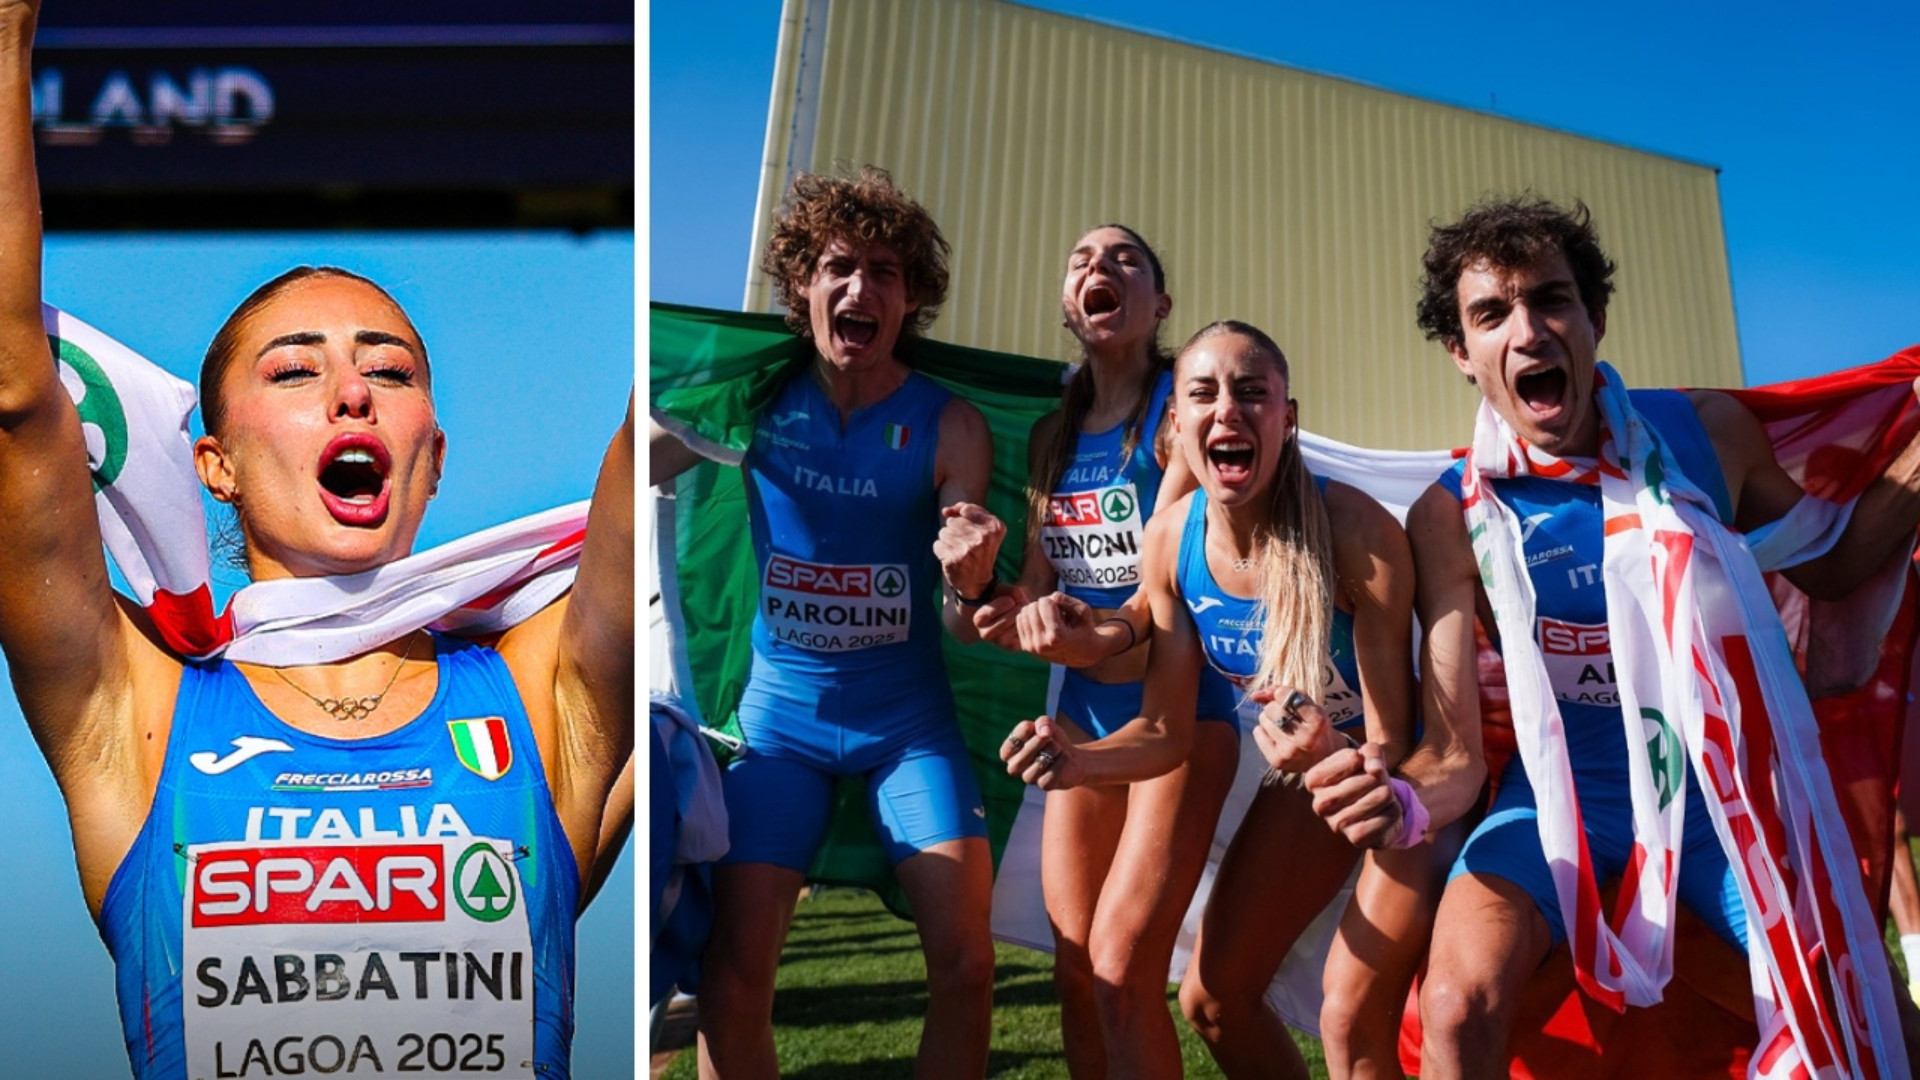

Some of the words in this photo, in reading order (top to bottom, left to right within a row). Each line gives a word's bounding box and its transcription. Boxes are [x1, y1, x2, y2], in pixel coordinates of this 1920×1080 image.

[32, 66, 275, 142] LAND
[794, 466, 878, 497] ITALIA
[1045, 531, 1138, 559] ZENONI
[770, 562, 868, 593] SPAR
[1096, 565, 1138, 584] 2025
[767, 597, 906, 626] PAROLINI
[776, 627, 843, 648] LAGOA
[848, 633, 894, 648] 2025
[274, 768, 433, 786] FRECCIAROSSA
[245, 804, 474, 840] ITALIA
[197, 856, 439, 916] SPAR
[196, 952, 522, 1007] SABBATINI
[216, 1033, 383, 1079] LAGOA
[397, 1032, 505, 1072] 2025
